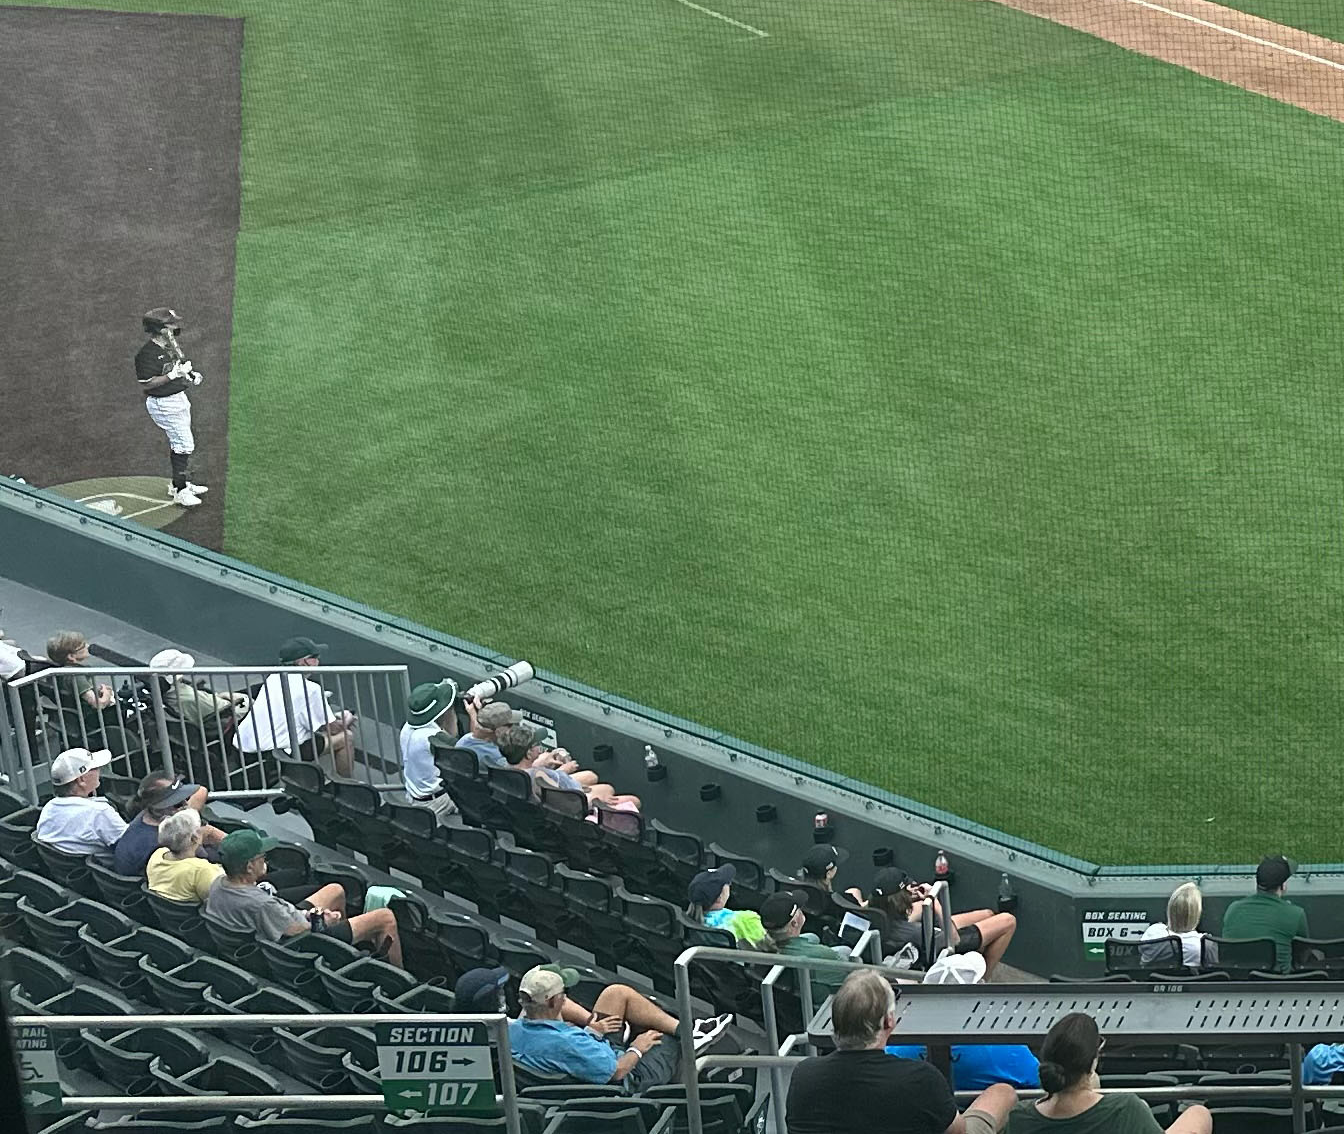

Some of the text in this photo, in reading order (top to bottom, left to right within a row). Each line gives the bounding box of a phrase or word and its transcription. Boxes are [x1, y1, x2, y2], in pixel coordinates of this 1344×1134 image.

[1085, 912, 1147, 920] BOX SEATING
[1087, 927, 1129, 937] BOX 6
[22, 1027, 48, 1038] RAIL
[389, 1027, 474, 1043] SECTION
[395, 1050, 448, 1073] 106
[427, 1082, 478, 1105] 107
